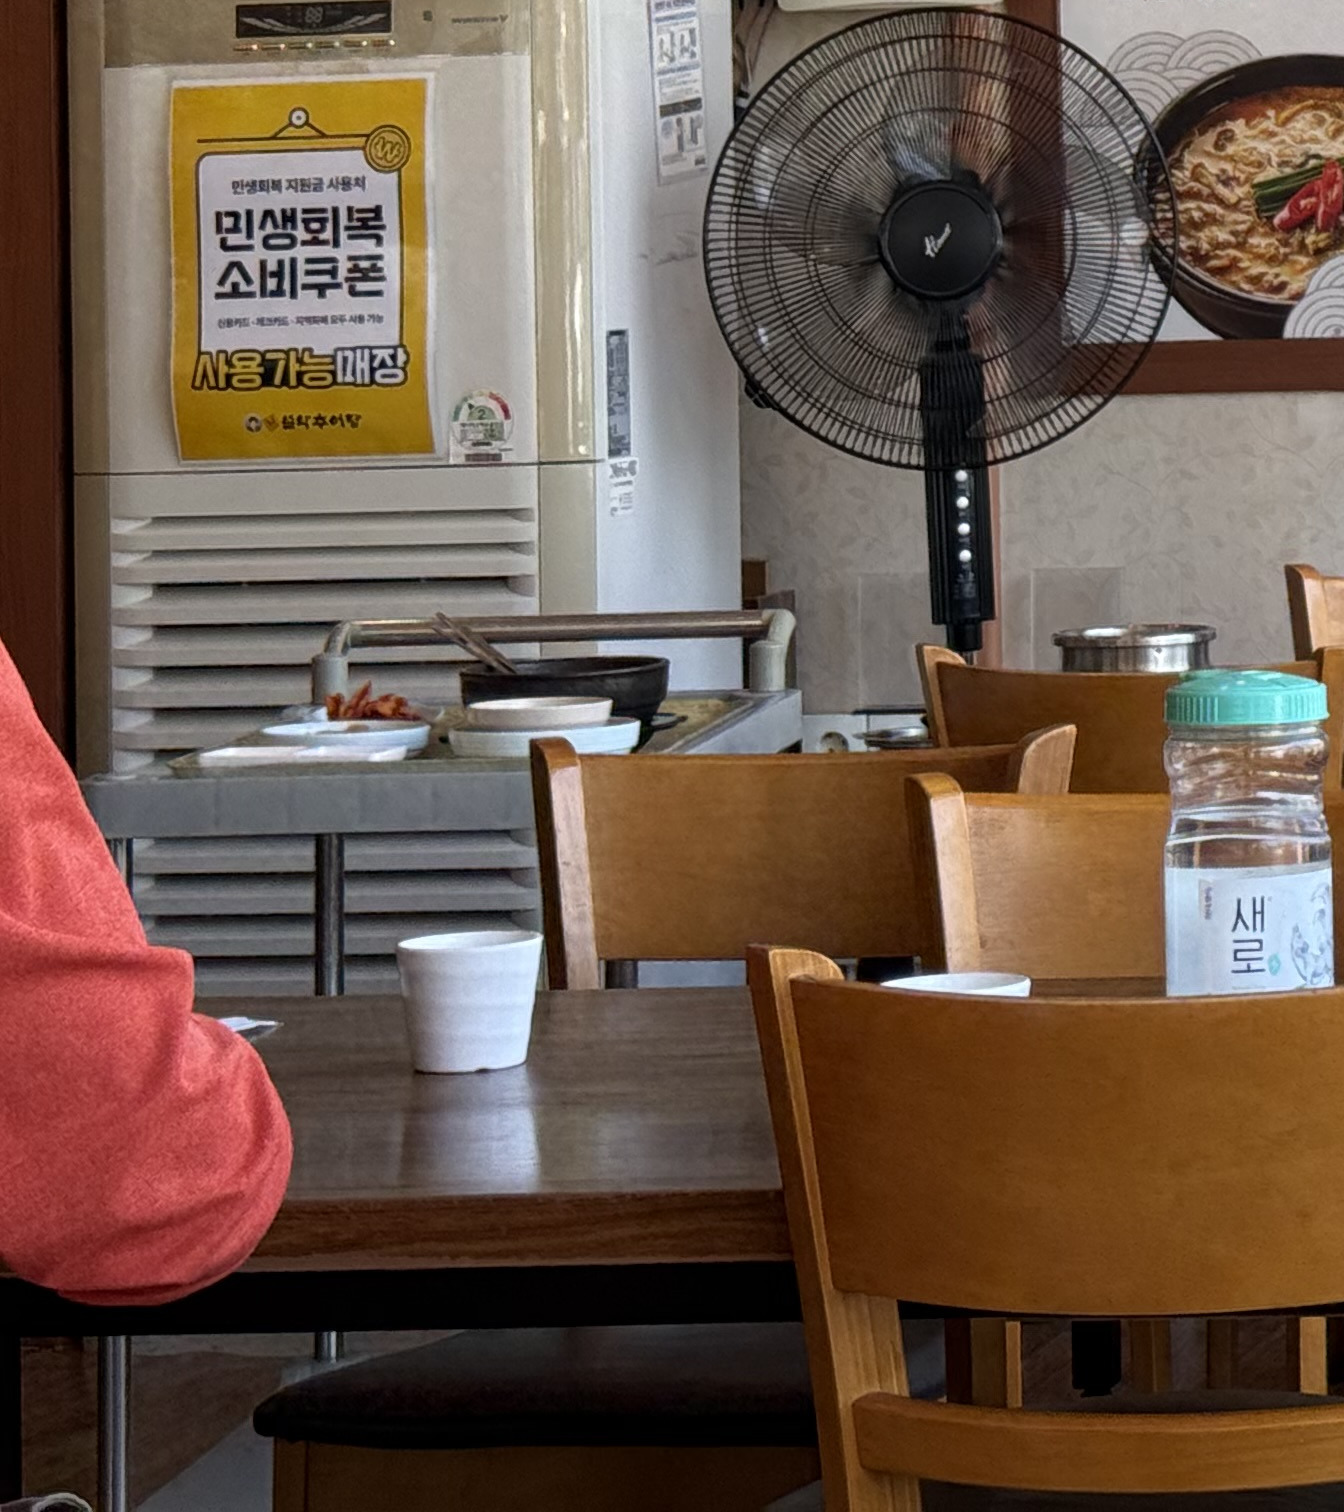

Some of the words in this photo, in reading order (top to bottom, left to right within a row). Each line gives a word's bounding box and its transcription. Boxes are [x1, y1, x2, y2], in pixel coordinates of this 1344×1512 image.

[214, 204, 388, 253] 민생회복
[214, 253, 388, 301] 소비쿠폰
[1231, 895, 1267, 974] 새로
